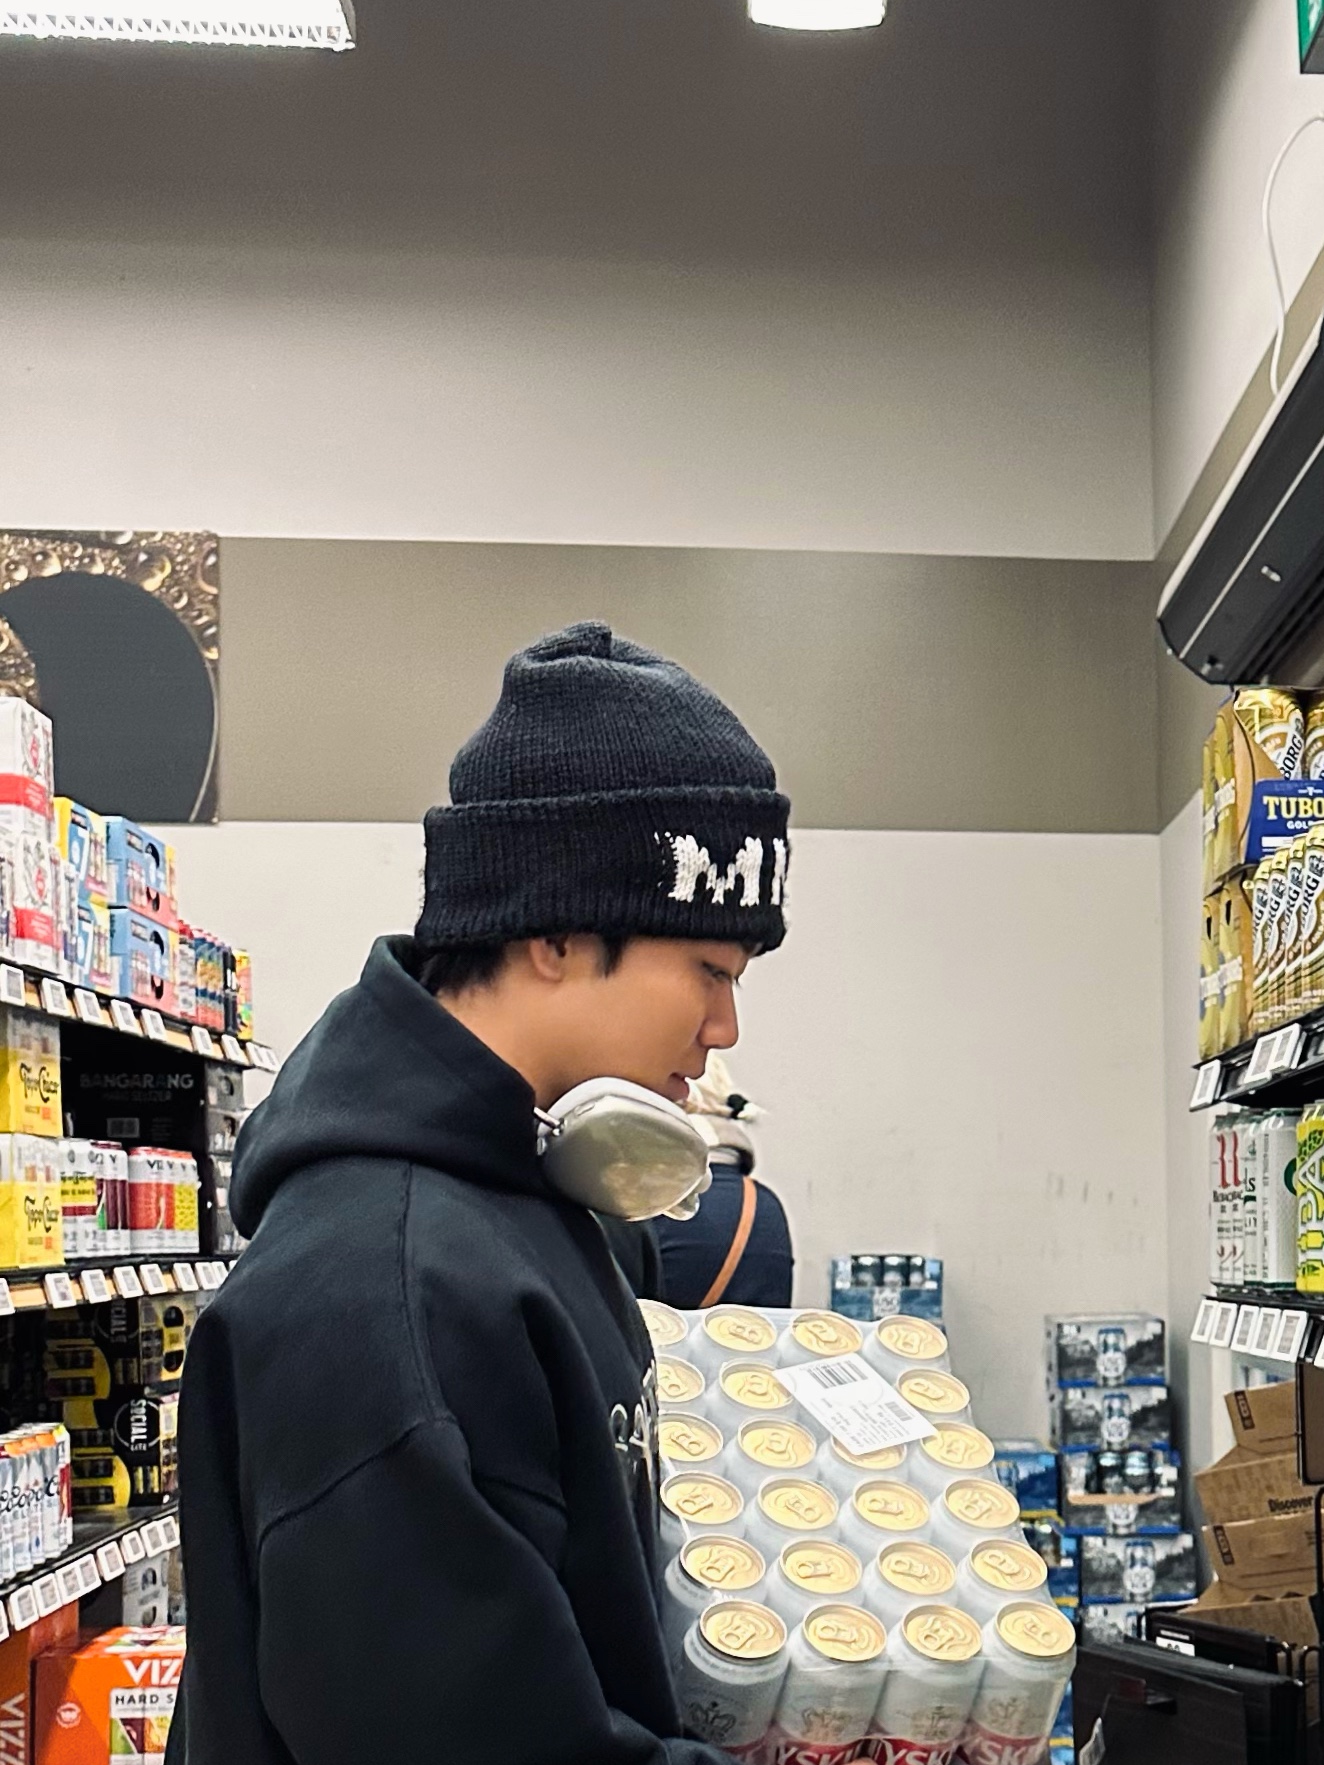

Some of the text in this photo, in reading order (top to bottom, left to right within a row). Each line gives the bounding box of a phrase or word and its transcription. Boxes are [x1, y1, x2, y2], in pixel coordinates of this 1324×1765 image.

[80, 1073, 194, 1090] BANGARANG
[1268, 1495, 1313, 1513] Discover
[115, 1693, 159, 1706] HARD
